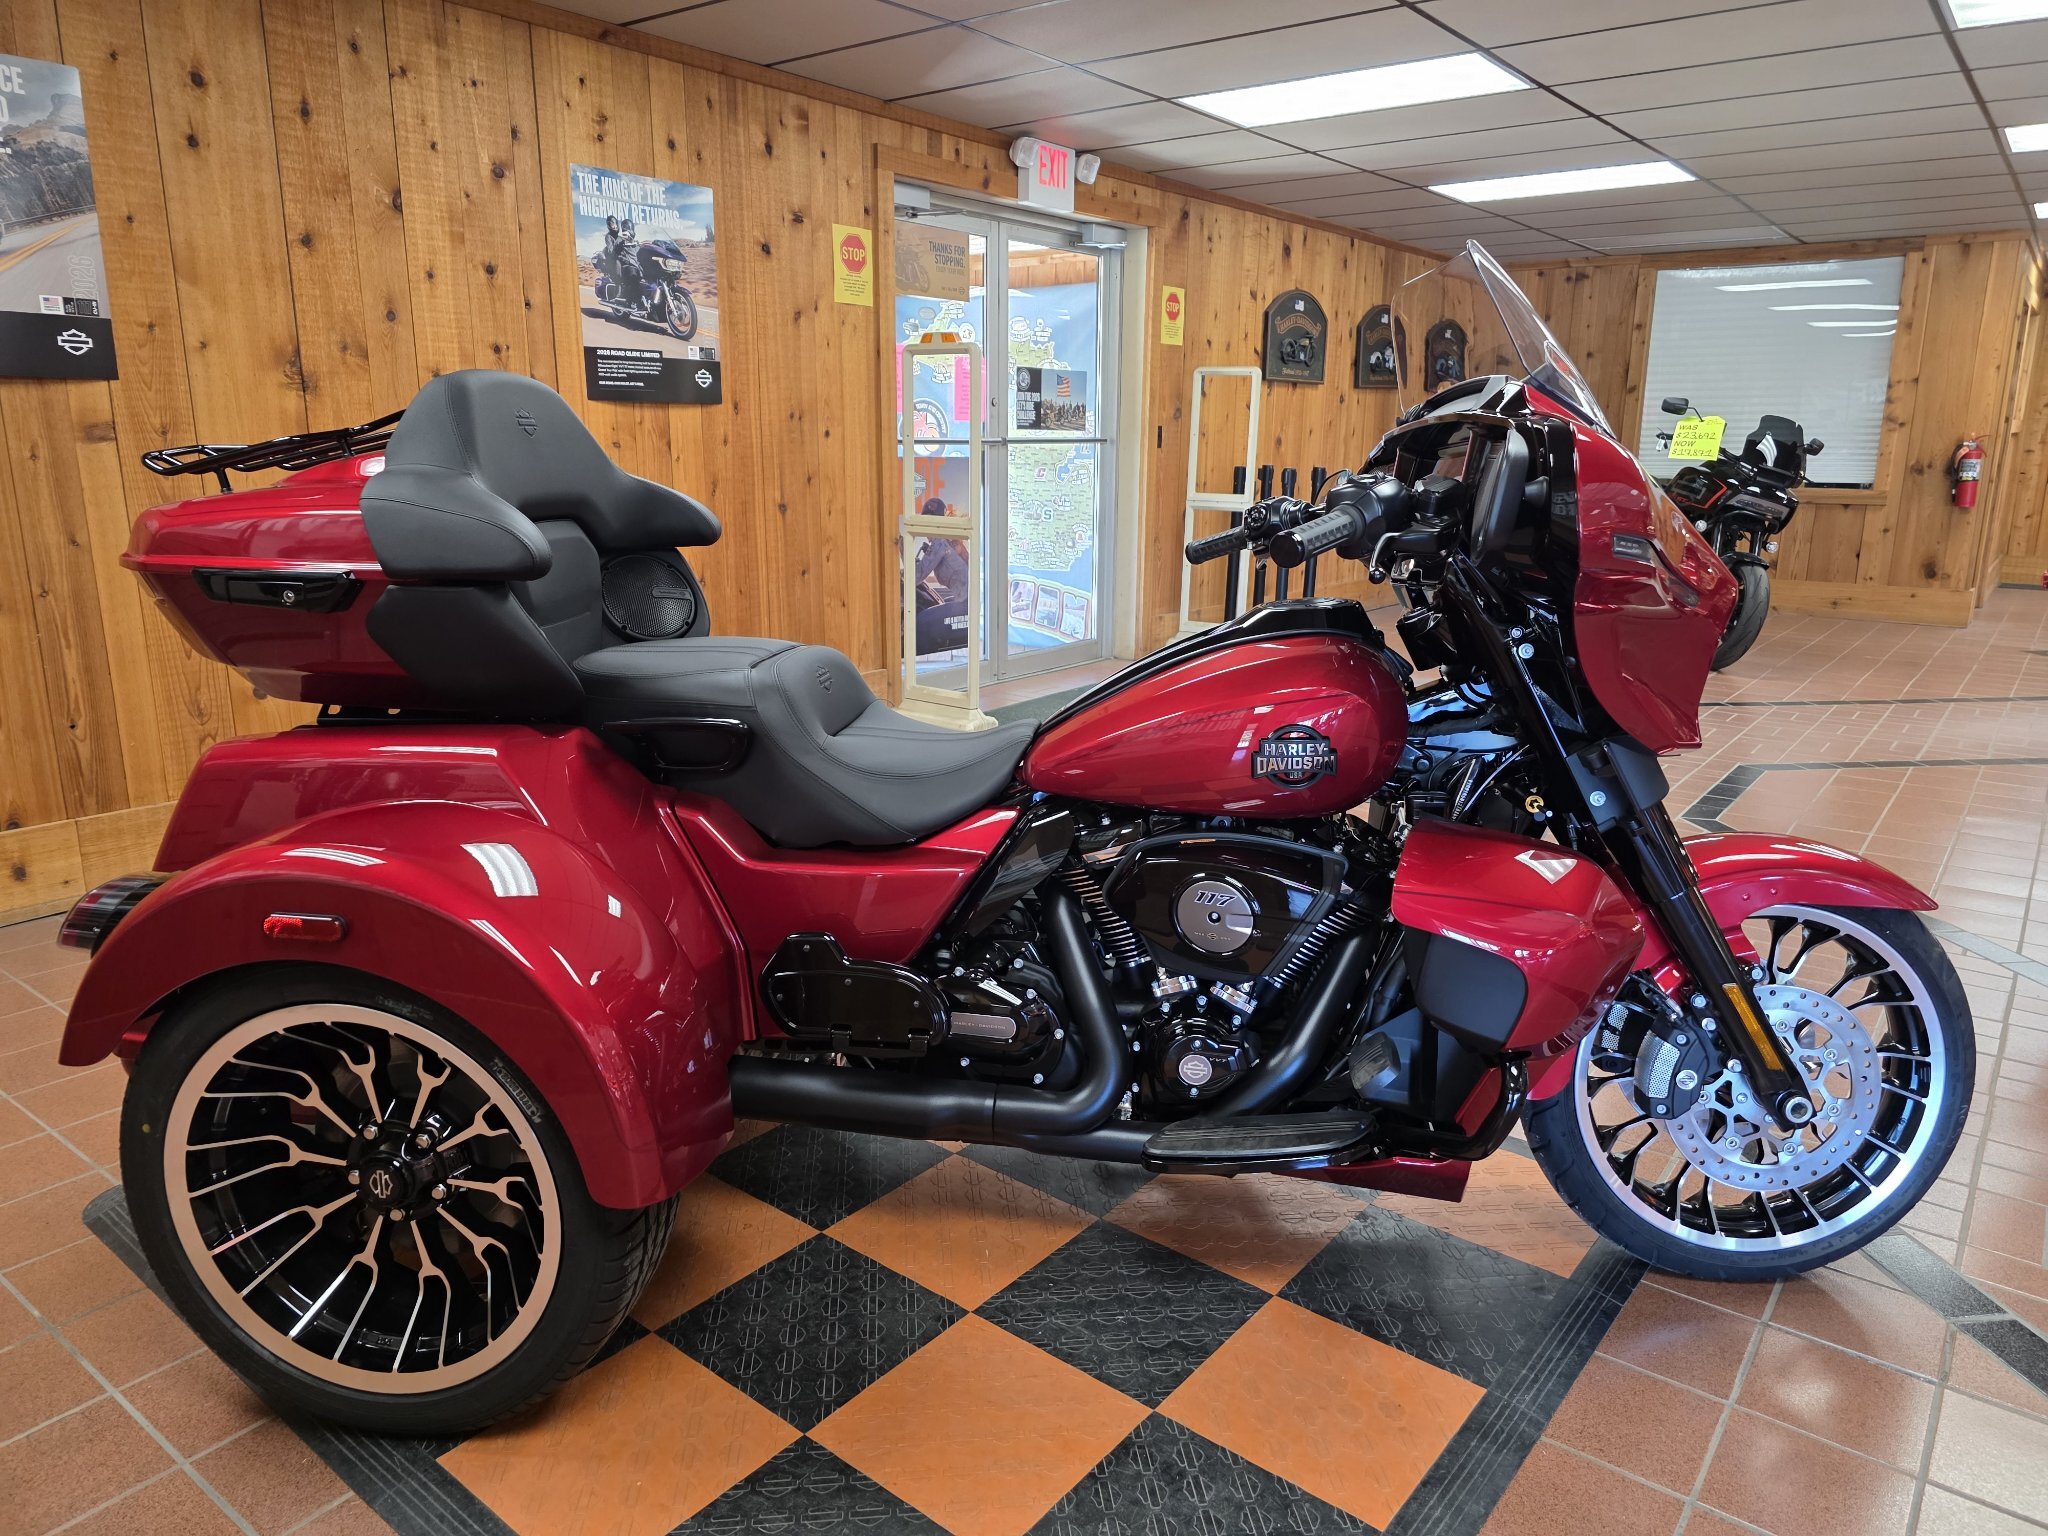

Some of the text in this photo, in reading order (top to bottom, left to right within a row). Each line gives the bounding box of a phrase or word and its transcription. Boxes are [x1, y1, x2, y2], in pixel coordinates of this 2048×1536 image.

[1039, 145, 1068, 190] EXIT
[577, 172, 667, 206] THE KING OF THE
[579, 196, 684, 230] HIGHWAY RETURNS.
[842, 246, 865, 262] STOP
[929, 241, 966, 257] THANKS FOR
[934, 254, 966, 269] STOPPING.
[1166, 301, 1180, 312] STOP
[1673, 440, 1697, 448] NOW
[1264, 743, 1329, 757] HARLEY-
[1256, 755, 1335, 775] DAVIDSON
[1194, 889, 1238, 907] 117
